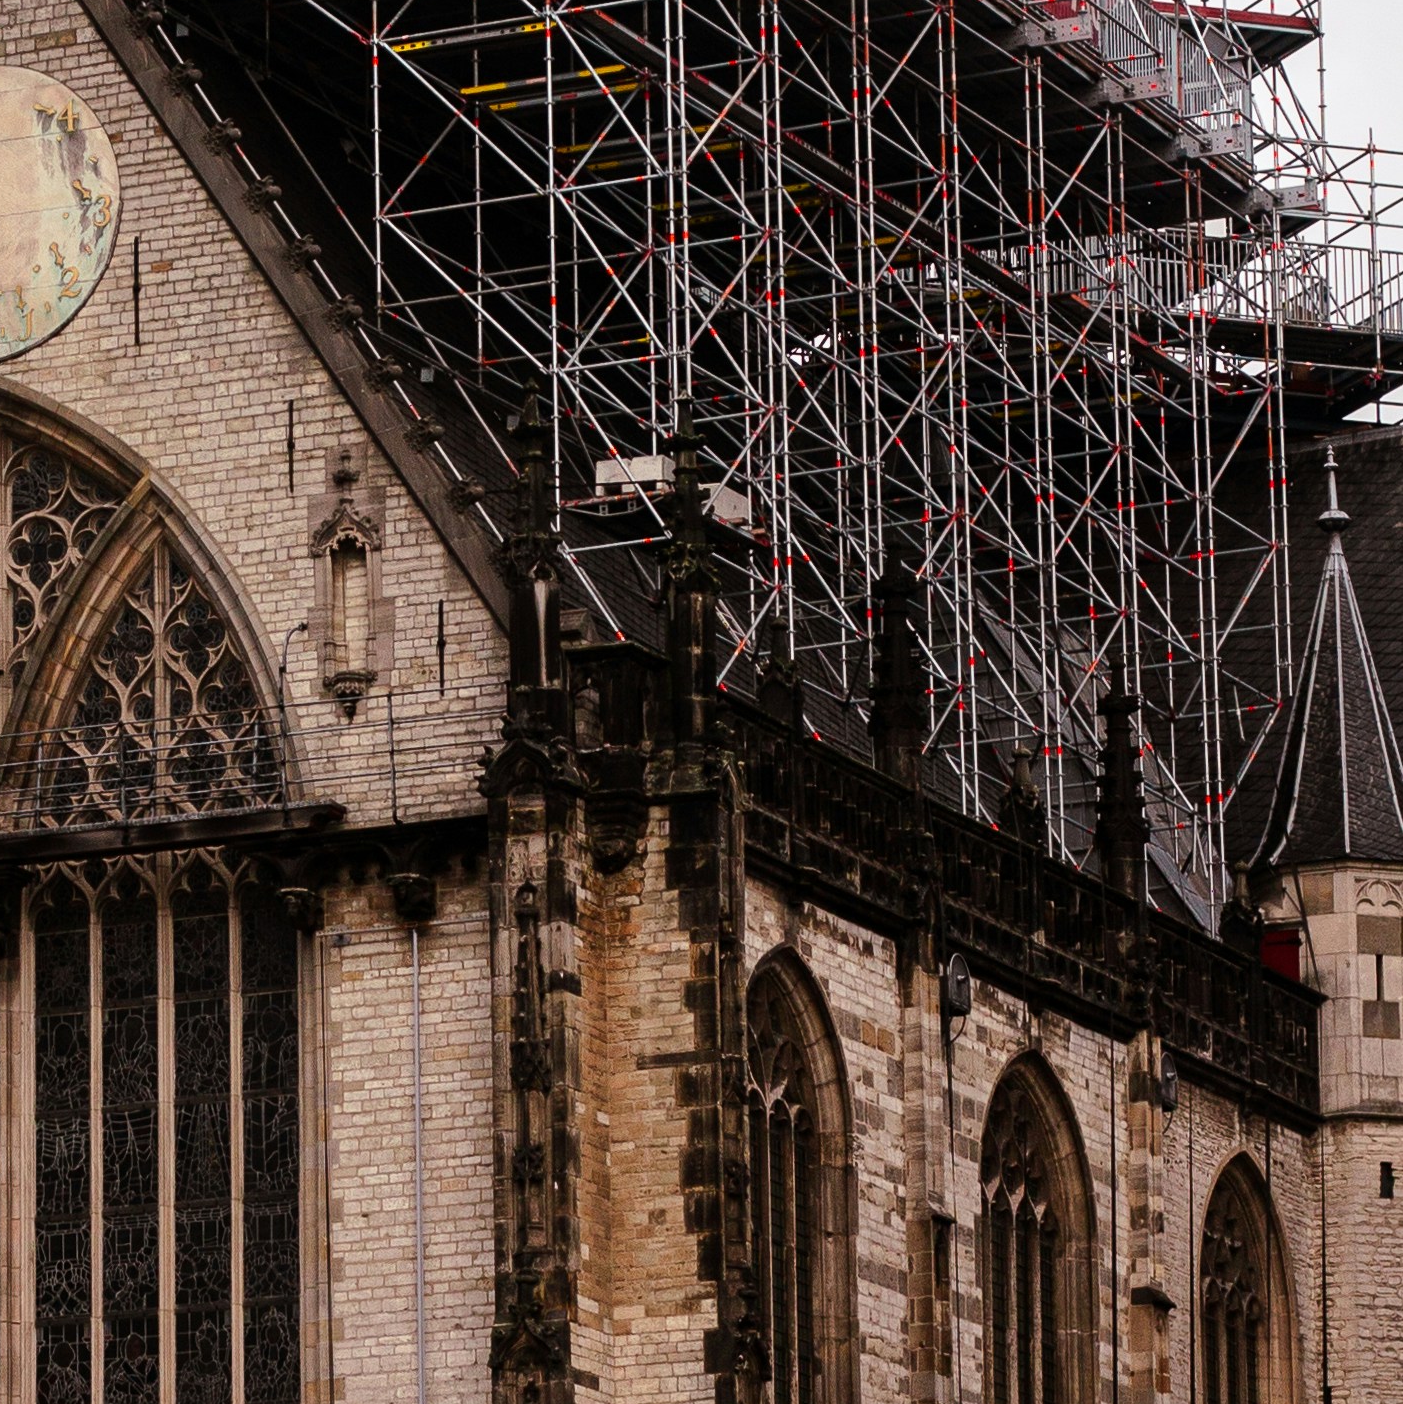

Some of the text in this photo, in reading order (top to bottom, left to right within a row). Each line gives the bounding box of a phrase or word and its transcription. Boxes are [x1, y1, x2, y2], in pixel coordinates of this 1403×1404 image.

[56, 100, 79, 132] 4
[93, 194, 111, 228] 3
[61, 267, 82, 299] 2
[18, 308, 35, 342] 1
